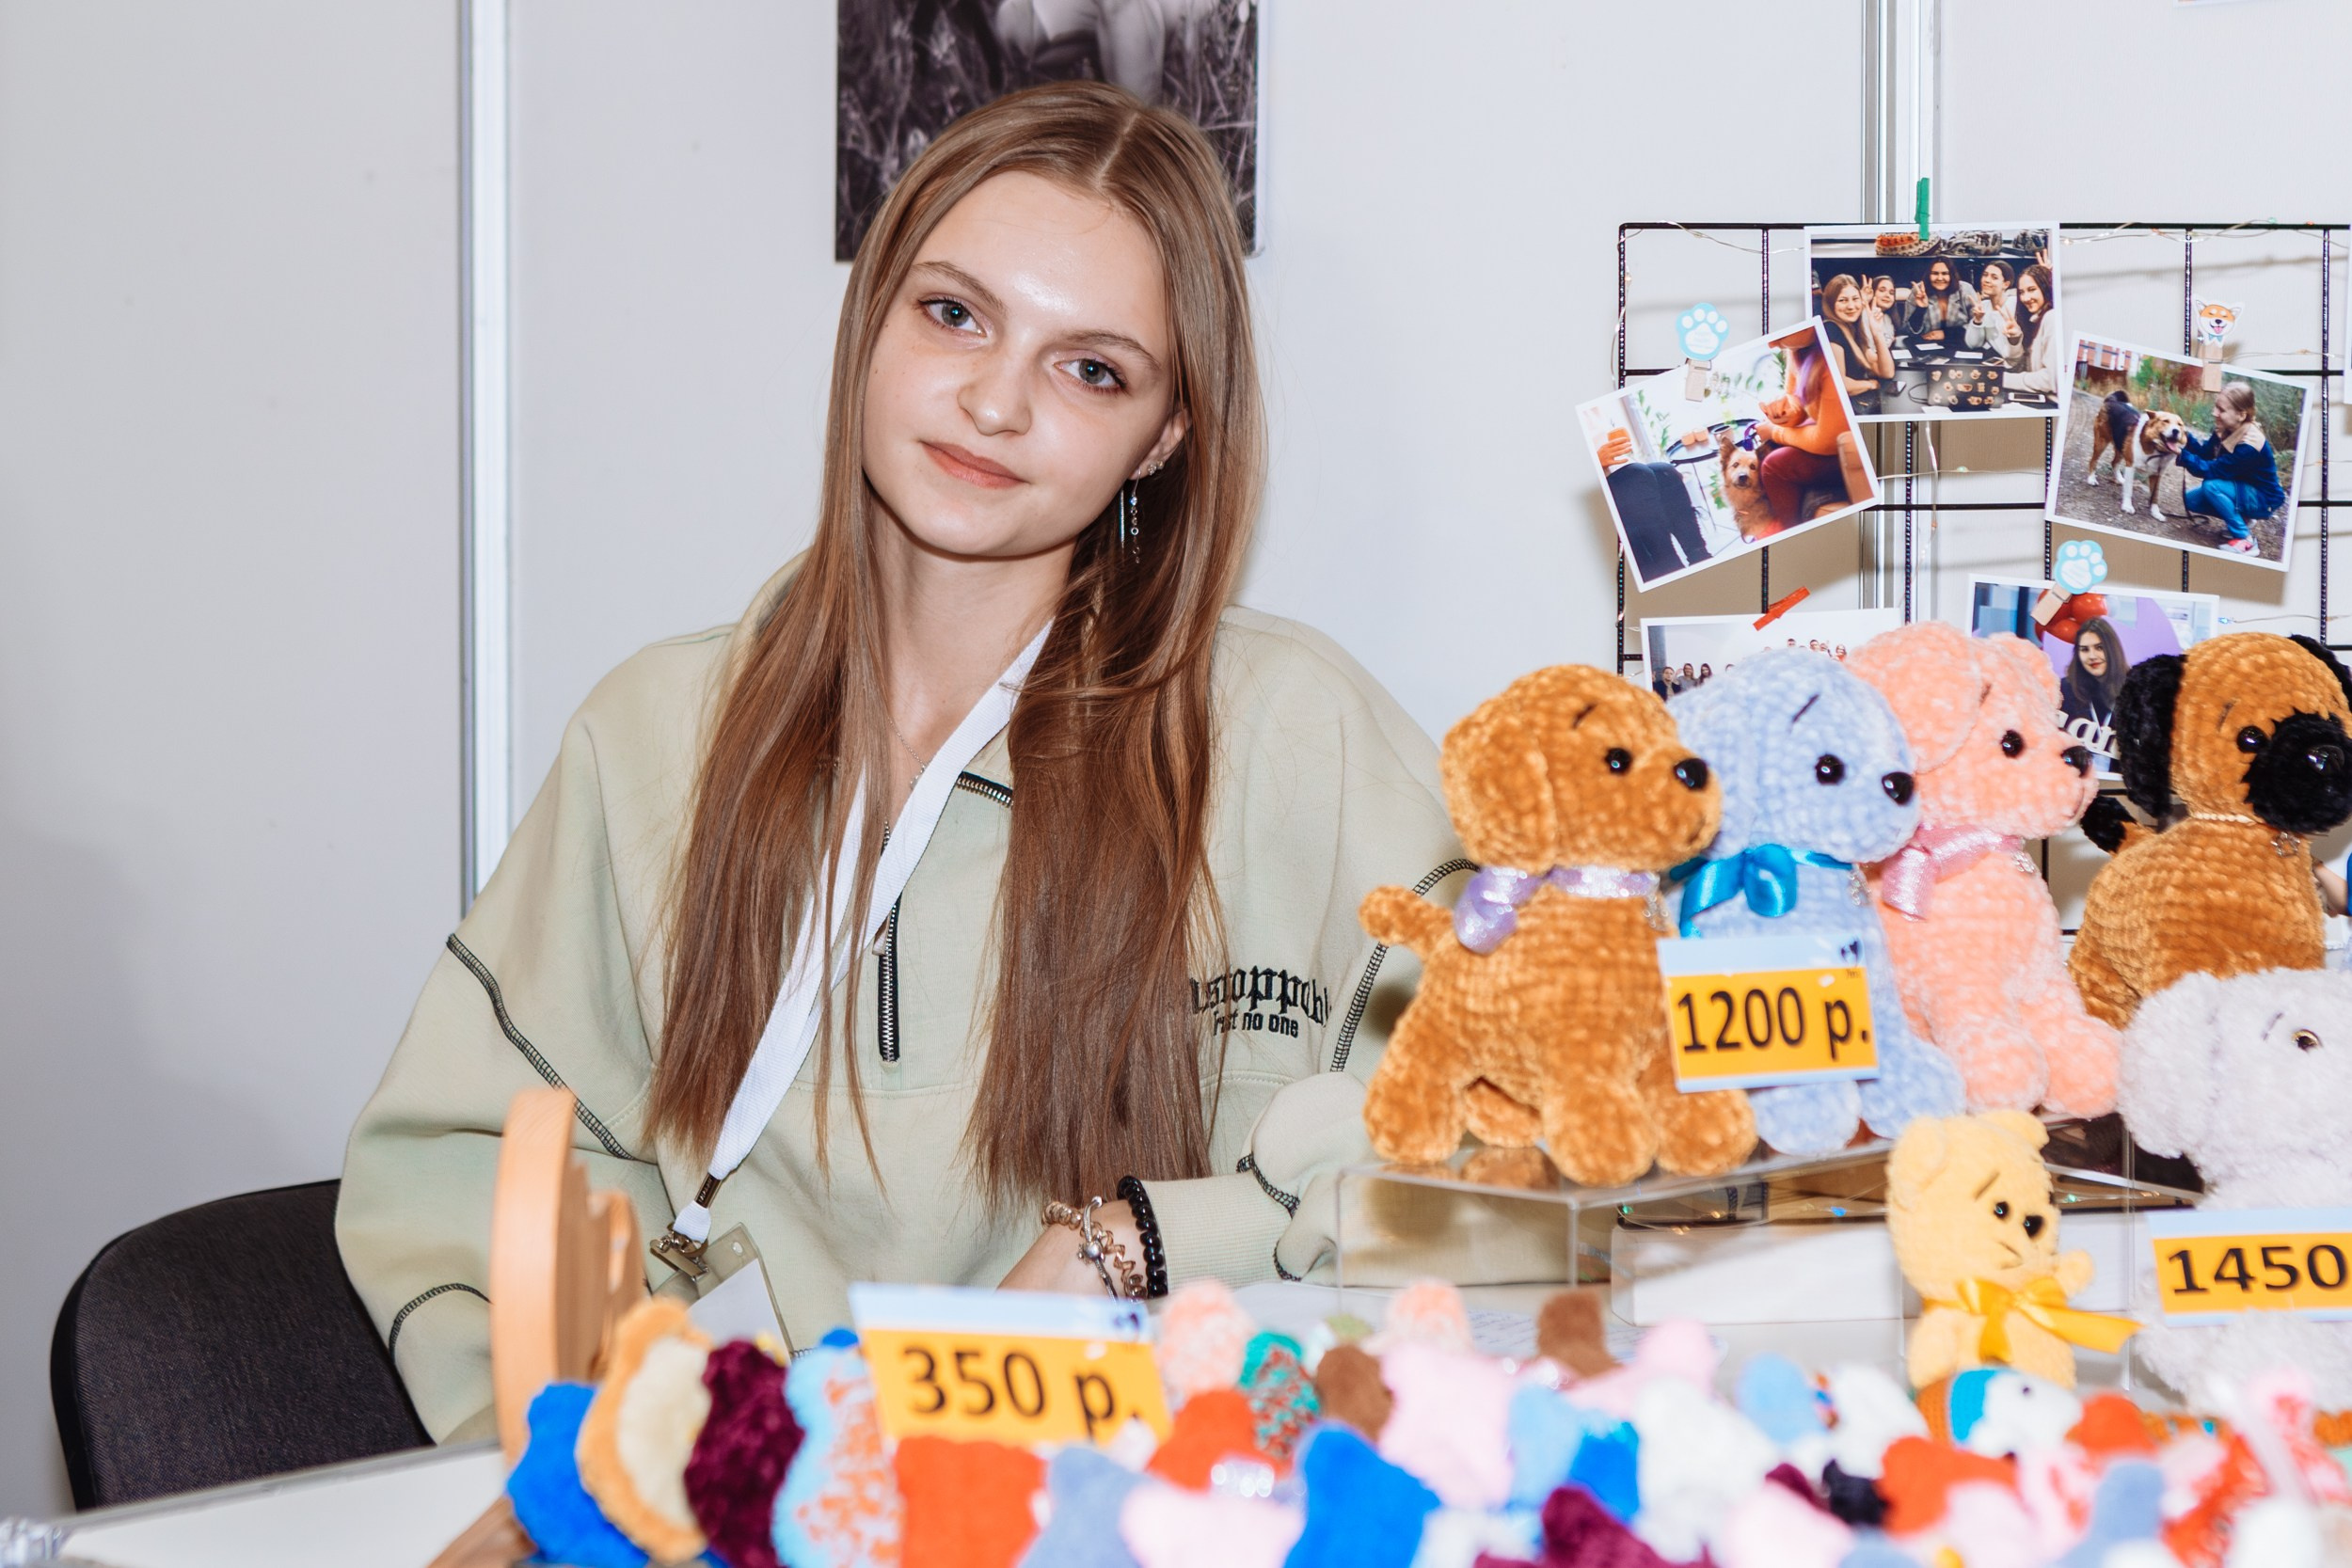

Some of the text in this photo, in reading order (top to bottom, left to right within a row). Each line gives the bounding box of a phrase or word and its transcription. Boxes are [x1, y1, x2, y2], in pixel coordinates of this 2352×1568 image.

[1242, 1012, 1263, 1030] no
[1269, 1014, 1299, 1038] one
[1677, 987, 1805, 1052] 1200
[2168, 1243, 2348, 1295] 1450
[902, 1346, 1044, 1418] 350
